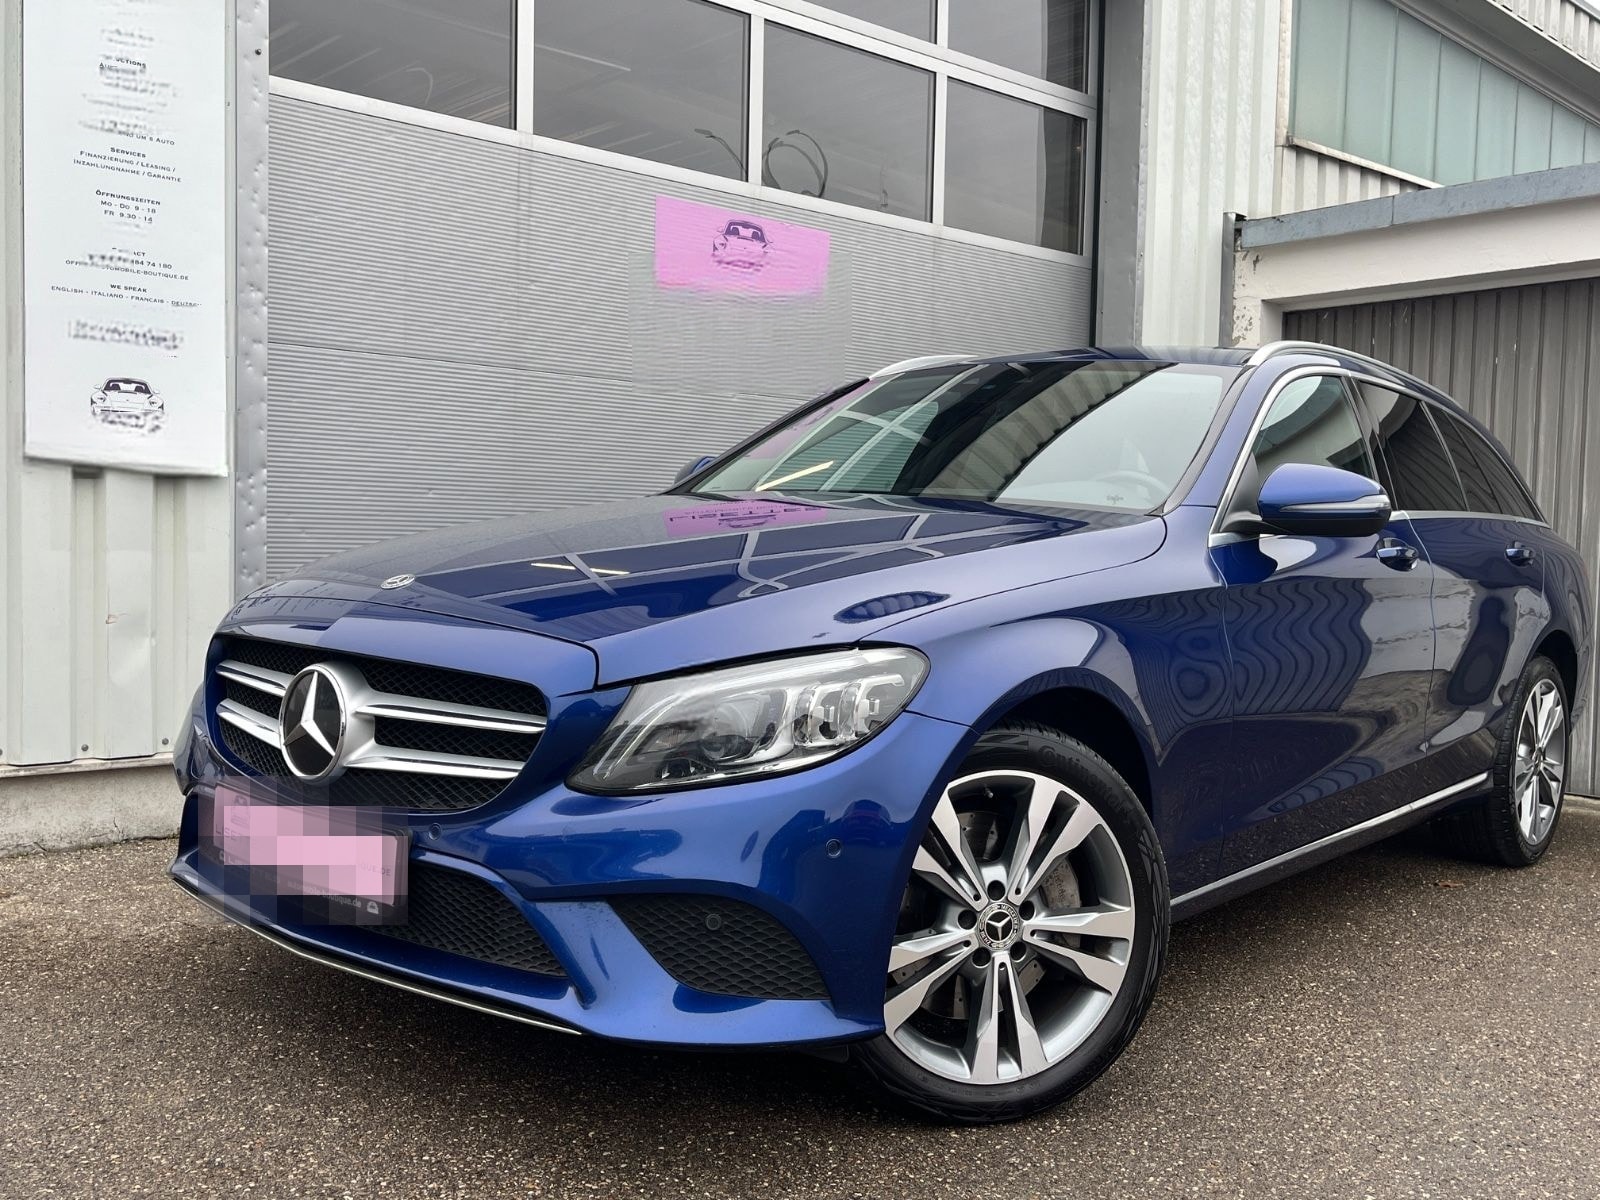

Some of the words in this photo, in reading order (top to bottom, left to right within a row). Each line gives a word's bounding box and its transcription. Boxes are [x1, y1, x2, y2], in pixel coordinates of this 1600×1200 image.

[110, 147, 146, 158] SERVICES
[80, 151, 135, 165] FINANZIERUNG
[140, 162, 171, 172] LEASING
[147, 172, 182, 183] GARANTIE
[95, 189, 161, 206] ÖFFNUNGSZEITEN
[51, 285, 84, 294] ENGLISH
[91, 290, 124, 299] ITALIANO
[124, 285, 147, 293] SPEAK
